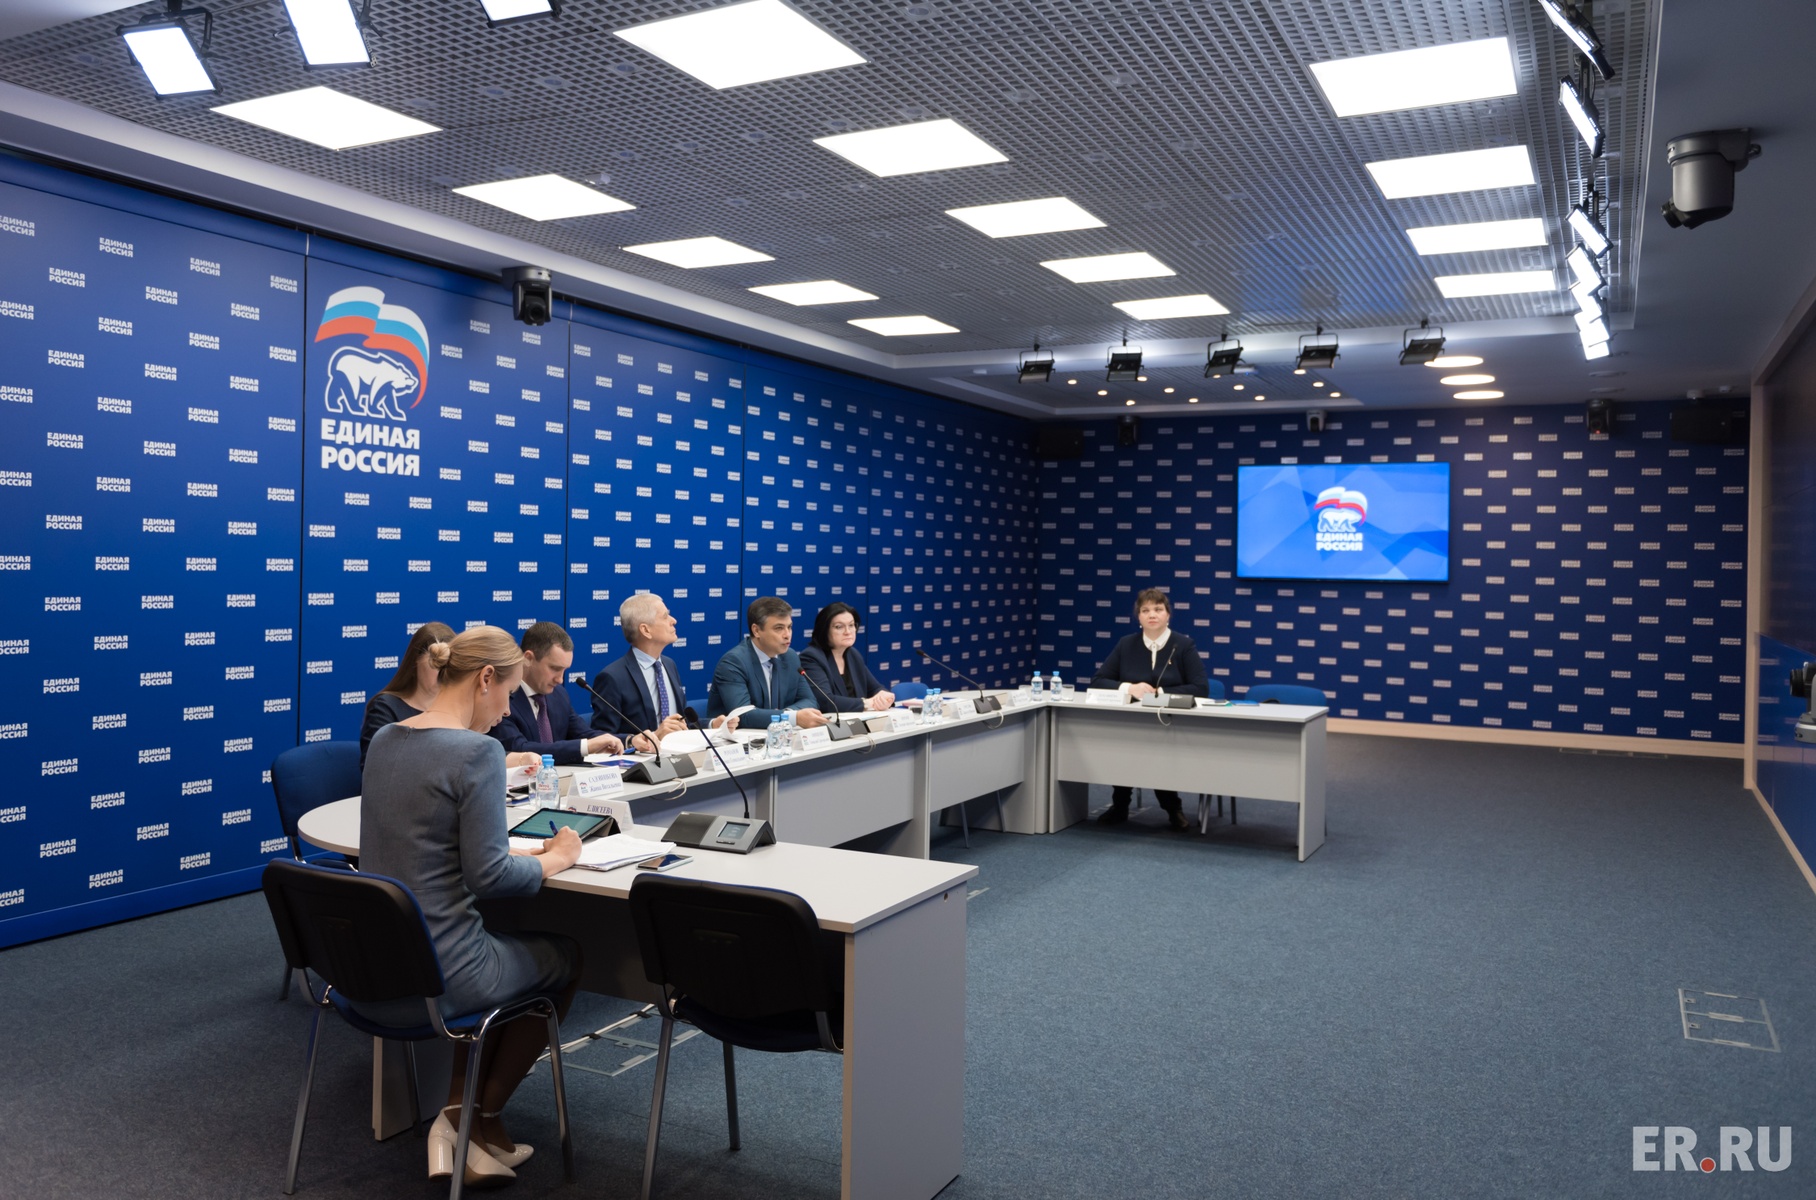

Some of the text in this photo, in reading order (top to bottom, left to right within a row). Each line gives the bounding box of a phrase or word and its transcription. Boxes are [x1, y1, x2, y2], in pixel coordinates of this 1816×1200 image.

[99, 237, 133, 250] ЕДИНАЯ
[99, 244, 133, 257] РОССИЯ
[190, 257, 220, 270] ЕДИНАЯ
[49, 267, 85, 280] ЕДИНАЯ
[190, 264, 220, 276] РОССИЯ
[49, 275, 85, 287] РОССИЯ
[270, 275, 297, 287] ЕДИНАЯ
[146, 286, 178, 298] ЕДИНАЯ
[270, 281, 297, 293] РОССИЯ
[146, 293, 177, 305] РОССИЯ
[231, 303, 259, 314] ЕДИНАЯ
[231, 309, 259, 320] РОССИЯ
[99, 317, 132, 329] ЕДИНАЯ
[98, 324, 132, 336] РОССИЯ
[189, 332, 219, 343] ЕДИНАЯ
[189, 338, 219, 350] РОССИЯ
[48, 350, 84, 361] ЕДИНАЯ
[269, 346, 296, 356] ЕДИНАЯ
[269, 352, 296, 362] РОССИЯ
[48, 357, 84, 368] РОССИЯ
[145, 363, 177, 374] ЕДИНАЯ
[145, 370, 177, 381] РОССИЯ
[230, 376, 259, 386] ЕДИНАЯ
[230, 382, 259, 392] РОССИЯ
[98, 397, 131, 407] ЕДИНАЯ
[97, 403, 131, 414] РОССИЯ
[188, 407, 218, 417] ЕДИНАЯ
[188, 414, 218, 423] РОССИЯ
[268, 417, 296, 426] ЕДИНАЯ
[268, 423, 296, 432] РОССИЯ
[47, 432, 83, 441] ЕДИНАЯ
[321, 418, 420, 450] ЕДИНАЯ
[47, 439, 83, 449] РОССИЯ
[144, 441, 176, 450] ЕДИНАЯ
[144, 447, 176, 457] РОССИЯ
[229, 448, 258, 457] ЕДИНАЯ
[229, 455, 258, 464] РОССИЯ
[321, 445, 420, 477] РОССИЯ
[97, 477, 131, 485] ЕДИНАЯ
[96, 483, 130, 492] РОССИЯ
[187, 482, 218, 491] ЕДИНАЯ
[267, 487, 295, 496] ЕДИНАЯ
[187, 489, 218, 497] РОССИЯ
[345, 492, 370, 500] ЕДИНАЯ
[409, 496, 432, 504] ЕДИНАЯ
[46, 515, 82, 523] ЕДИНАЯ
[143, 518, 175, 526] ЕДИНАЯ
[46, 522, 82, 530] РОССИЯ
[143, 525, 175, 533] РОССИЯ
[228, 521, 257, 529] ЕДИНАЯ
[309, 524, 335, 532] ЕДИНАЯ
[1316, 532, 1363, 542] ЕДИНАЯ
[1316, 542, 1363, 551] РОССИЯ
[95, 556, 129, 564] ЕДИНАЯ
[45, 603, 81, 611] РОССИЯ
[265, 628, 292, 636] ЕДИНАЯ
[94, 635, 128, 643] ЕДИНАЯ
[185, 638, 215, 646] РОССИЯ
[265, 634, 292, 642] РОССИЯ
[94, 642, 128, 650] РОССИЯ
[307, 660, 333, 668] ЕДИНАЯ
[226, 666, 254, 674] ЕДИНАЯ
[307, 666, 333, 674] РОССИЯ
[140, 671, 172, 680] ЕДИНАЯ
[225, 672, 254, 680] РОССИЯ
[43, 678, 79, 686] ЕДИНАЯ
[140, 678, 172, 686] РОССИЯ
[43, 684, 79, 694] РОССИЯ
[341, 691, 366, 699] ЕДИНАЯ
[341, 696, 366, 704] РОССИЯ
[264, 698, 291, 707] ЕДИНАЯ
[184, 705, 214, 714] ЕДИНАЯ
[264, 704, 291, 713] РОССИЯ
[93, 713, 126, 723] ЕДИНАЯ
[183, 711, 214, 721] РОССИЯ
[92, 720, 126, 730] РОССИЯ
[305, 728, 331, 736] ЕДИНАЯ
[224, 737, 253, 747] ЕДИНАЯ
[305, 733, 331, 742] РОССИЯ
[139, 747, 171, 757] ЕДИНАЯ
[224, 743, 253, 753] РОССИЯ
[42, 758, 78, 769] ЕДИНАЯ
[139, 753, 170, 764] РОССИЯ
[42, 765, 78, 776] РОССИЯ
[182, 779, 212, 789] ЕДИНАЯ
[182, 785, 212, 796] РОССИЯ
[91, 792, 125, 802] ЕДИНАЯ
[91, 798, 125, 809] РОССИЯ
[222, 809, 251, 819] ЕДИНАЯ
[222, 815, 251, 826] РОССИЯ
[137, 823, 169, 834] ЕДИНАЯ
[137, 829, 169, 841] РОССИЯ
[40, 839, 76, 851] ЕДИНАЯ
[261, 836, 288, 848] ЕДИНАЯ
[40, 846, 76, 858] РОССИЯ
[261, 842, 288, 853] РОССИЯ
[180, 852, 210, 864] ЕДИНАЯ
[180, 858, 210, 870] РОССИЯ
[89, 869, 123, 881] ЕДИНАЯ
[89, 876, 123, 889] РОССИЯ
